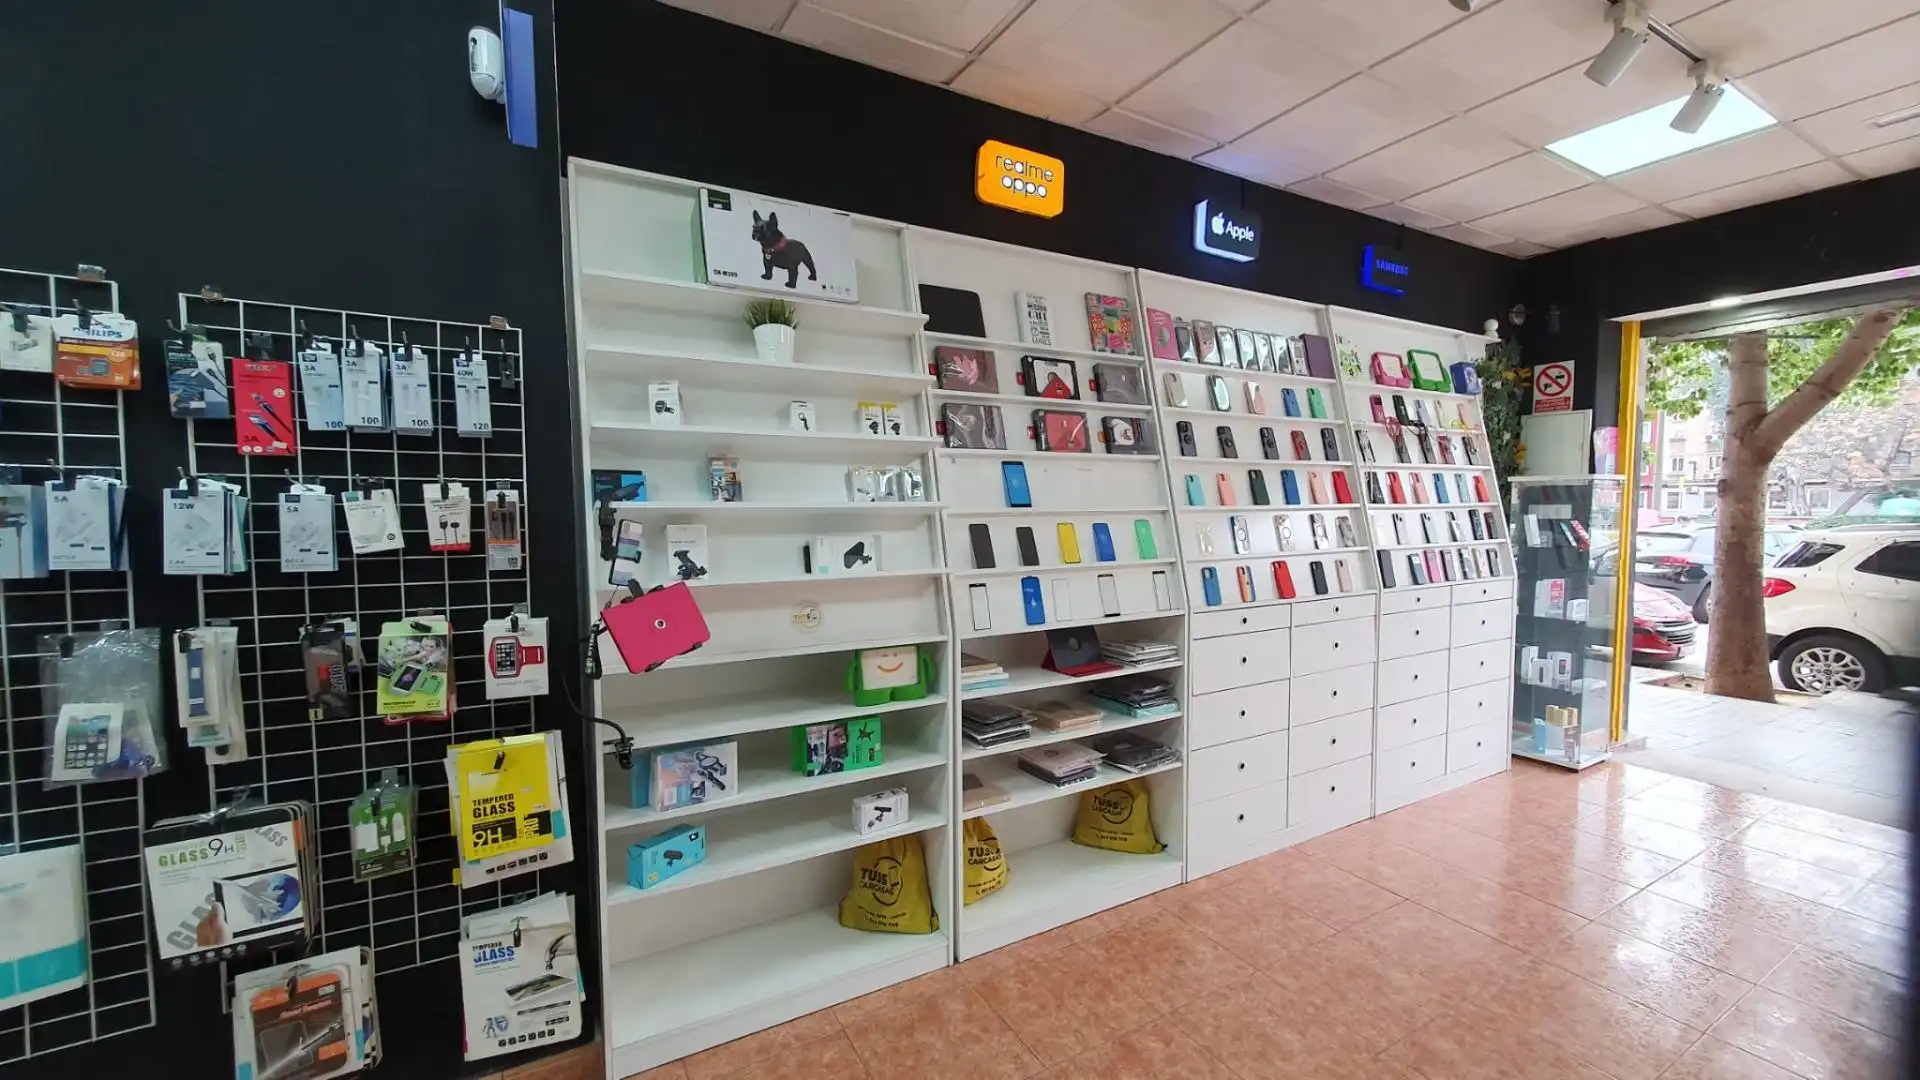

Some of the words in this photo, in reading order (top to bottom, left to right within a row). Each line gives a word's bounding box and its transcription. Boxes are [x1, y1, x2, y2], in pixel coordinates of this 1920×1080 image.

[995, 155, 1054, 182] realme
[1001, 175, 1048, 198] oppo
[1226, 221, 1254, 241] Apple
[1376, 259, 1410, 276] SAMSUNG
[73, 325, 123, 339] ILIPS
[304, 364, 316, 372] 3A
[325, 420, 344, 429] 100
[361, 416, 380, 425] 100
[411, 419, 430, 427] 100
[473, 422, 490, 430] 120
[473, 794, 515, 807] TEMPERED
[472, 801, 516, 819] GLASS
[254, 826, 289, 848] LASS
[473, 827, 503, 847] 9H
[159, 849, 209, 866] GLASS
